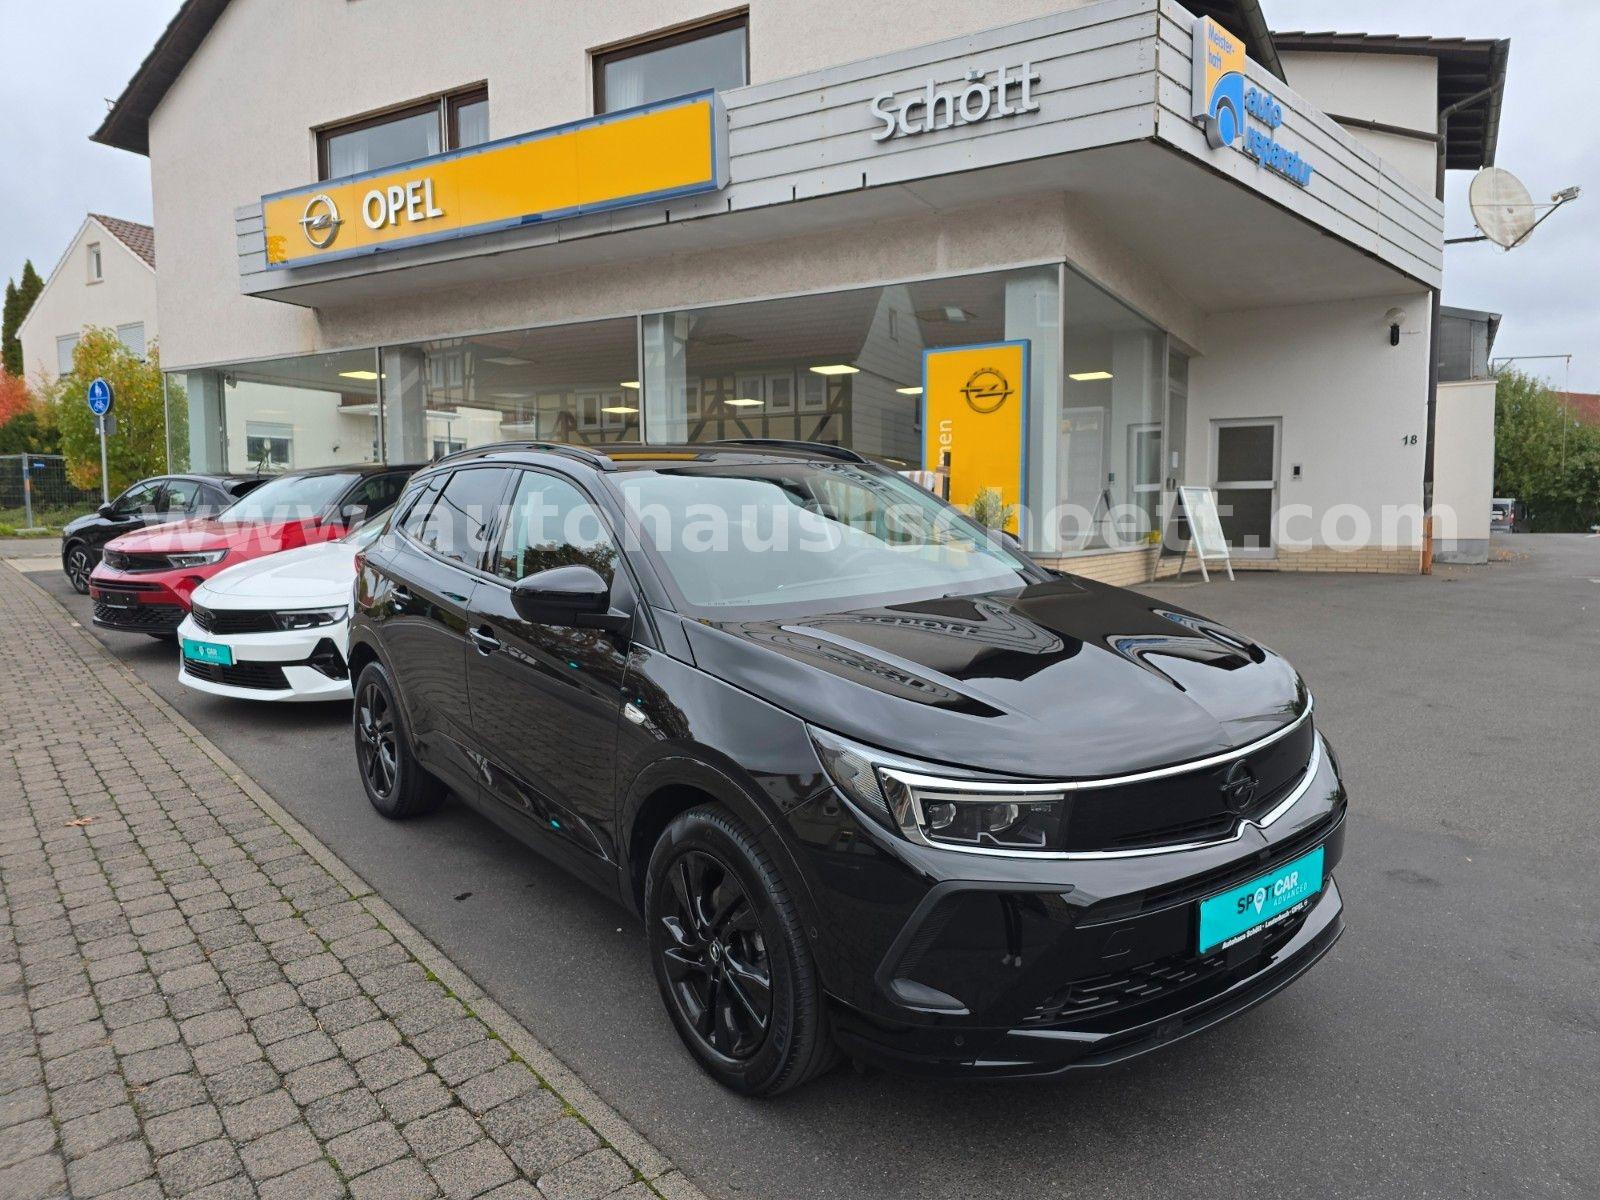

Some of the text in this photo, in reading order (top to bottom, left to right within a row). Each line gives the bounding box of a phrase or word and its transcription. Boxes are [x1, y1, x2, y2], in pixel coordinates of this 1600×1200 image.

[871, 61, 1041, 143] Schött
[1246, 87, 1282, 129] auto
[1247, 126, 1314, 187] reparatur
[362, 178, 444, 229] OPEL
[1401, 434, 1418, 446] 18
[1273, 882, 1308, 906] ADVANCED
